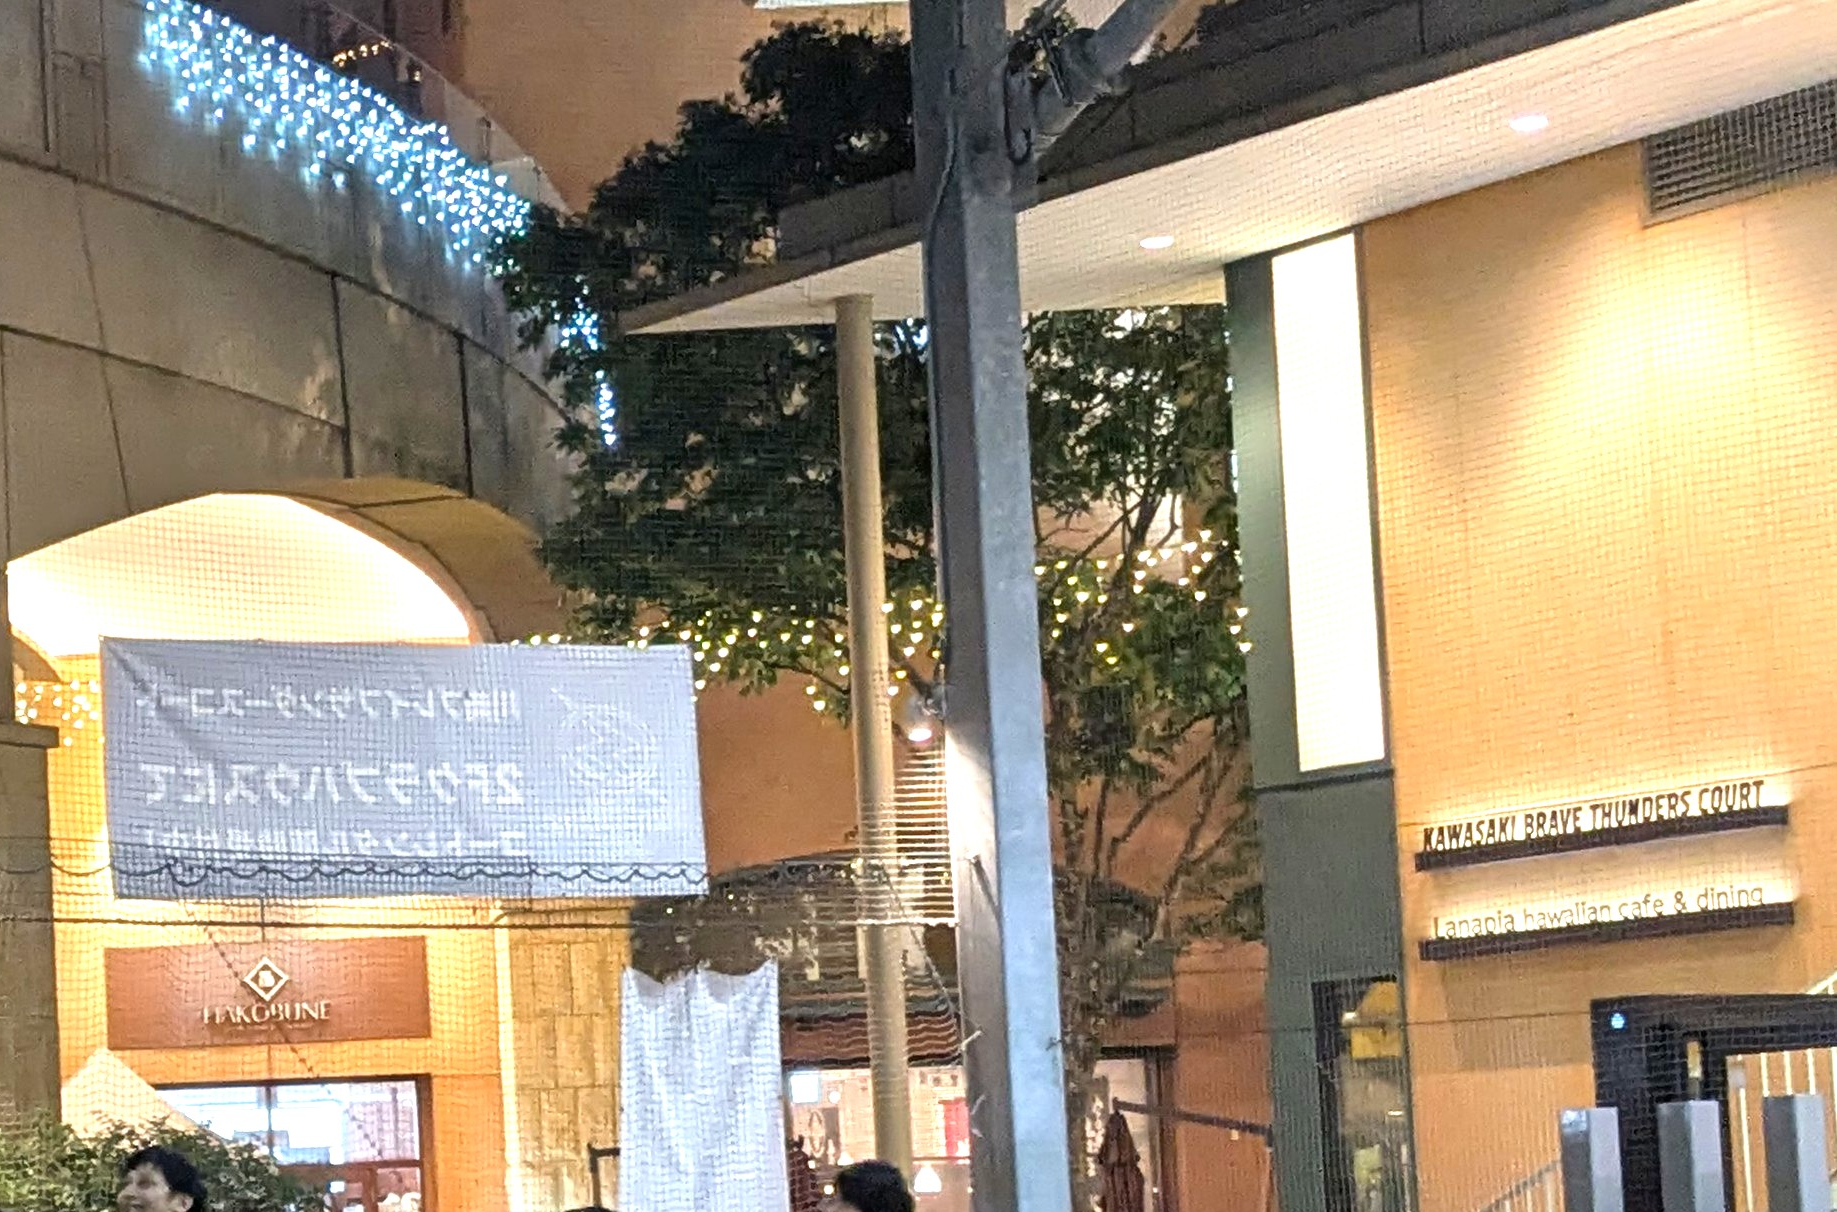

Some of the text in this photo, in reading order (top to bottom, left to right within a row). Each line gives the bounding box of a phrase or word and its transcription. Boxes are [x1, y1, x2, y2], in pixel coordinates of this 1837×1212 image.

[1422, 780, 1764, 851] KAWASAKI BRAVE THUNDERS COURT
[1619, 892, 1664, 922] cafe
[1672, 890, 1688, 913] &
[1696, 884, 1764, 912] dining
[202, 999, 332, 1025] HAKOBUNE
